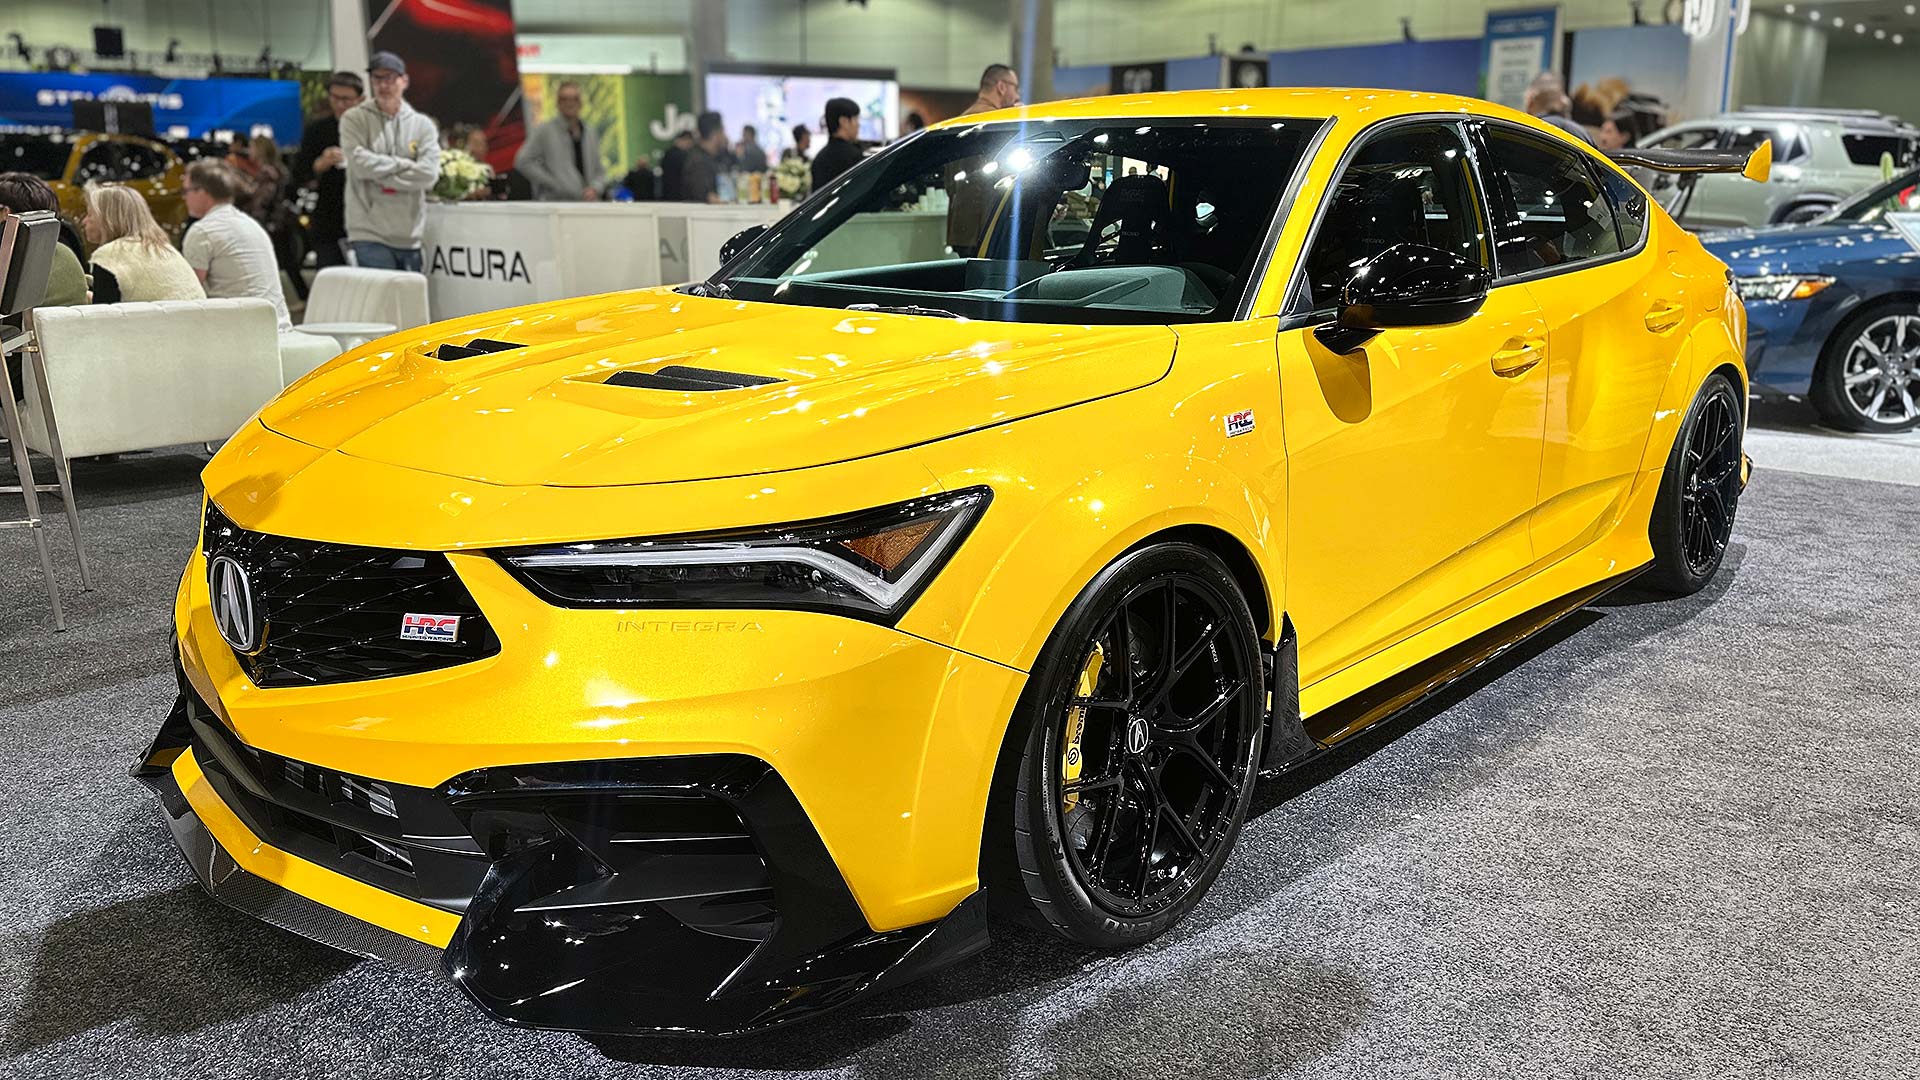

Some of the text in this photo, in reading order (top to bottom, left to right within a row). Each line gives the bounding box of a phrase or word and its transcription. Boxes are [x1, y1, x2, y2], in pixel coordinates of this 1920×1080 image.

[431, 245, 531, 284] ACURA
[1227, 411, 1253, 431] HRC
[404, 616, 456, 636] HRC
[617, 620, 765, 632] INTEGRA
